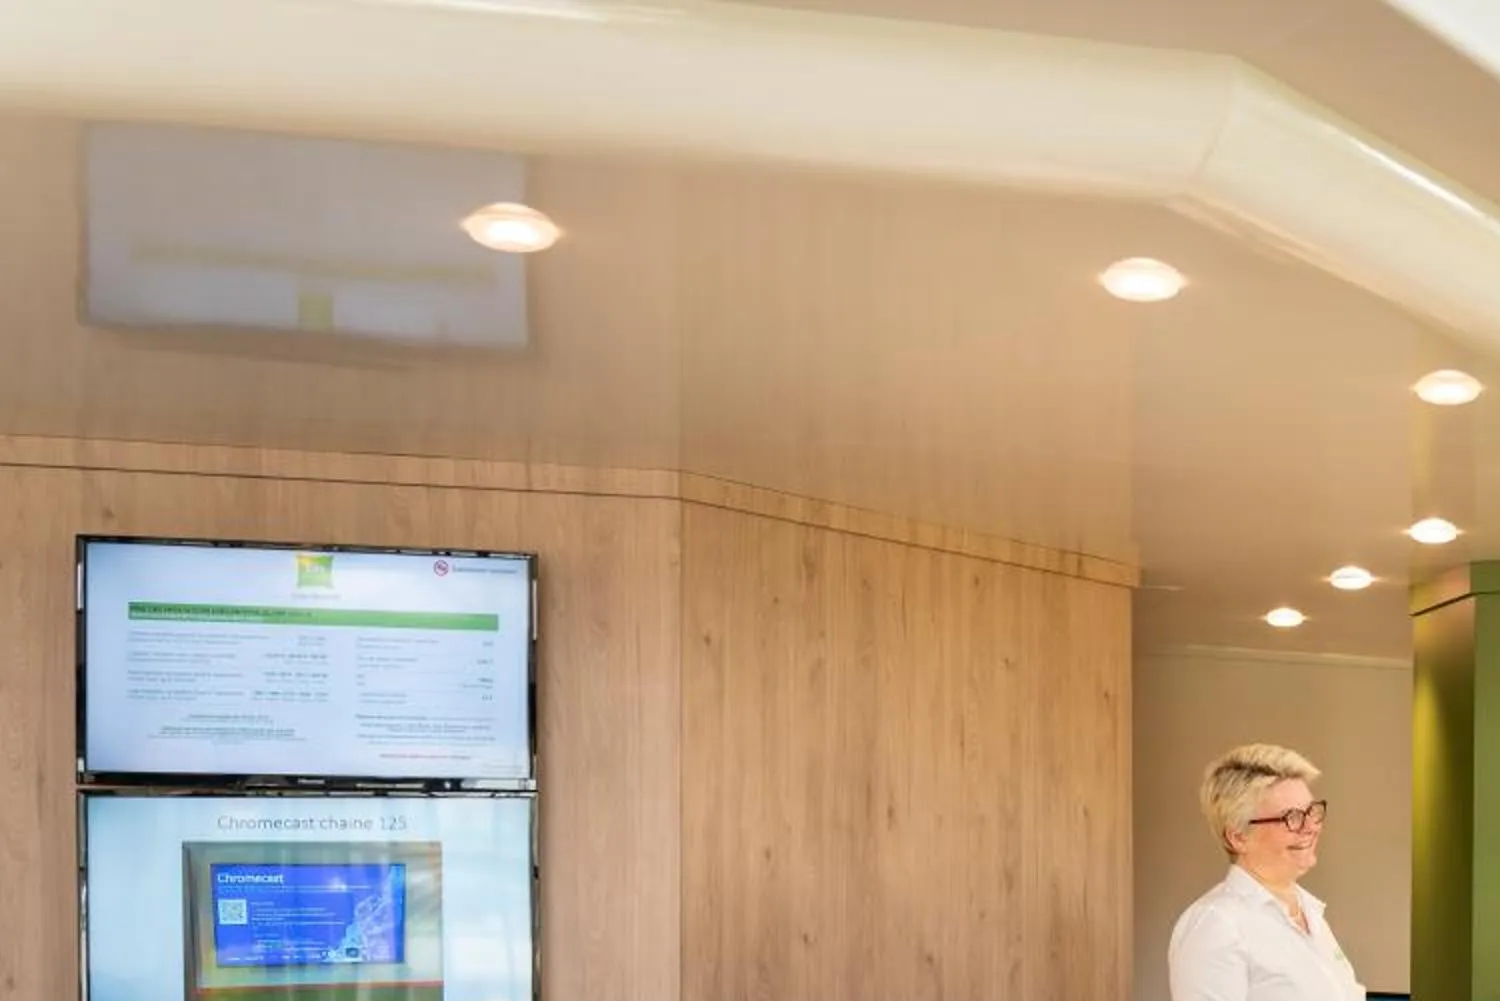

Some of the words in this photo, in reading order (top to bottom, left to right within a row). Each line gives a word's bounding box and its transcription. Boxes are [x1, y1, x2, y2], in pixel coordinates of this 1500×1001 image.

[217, 815, 314, 830] Chromecast
[379, 816, 407, 831] 125
[217, 873, 284, 884] Chromecast
